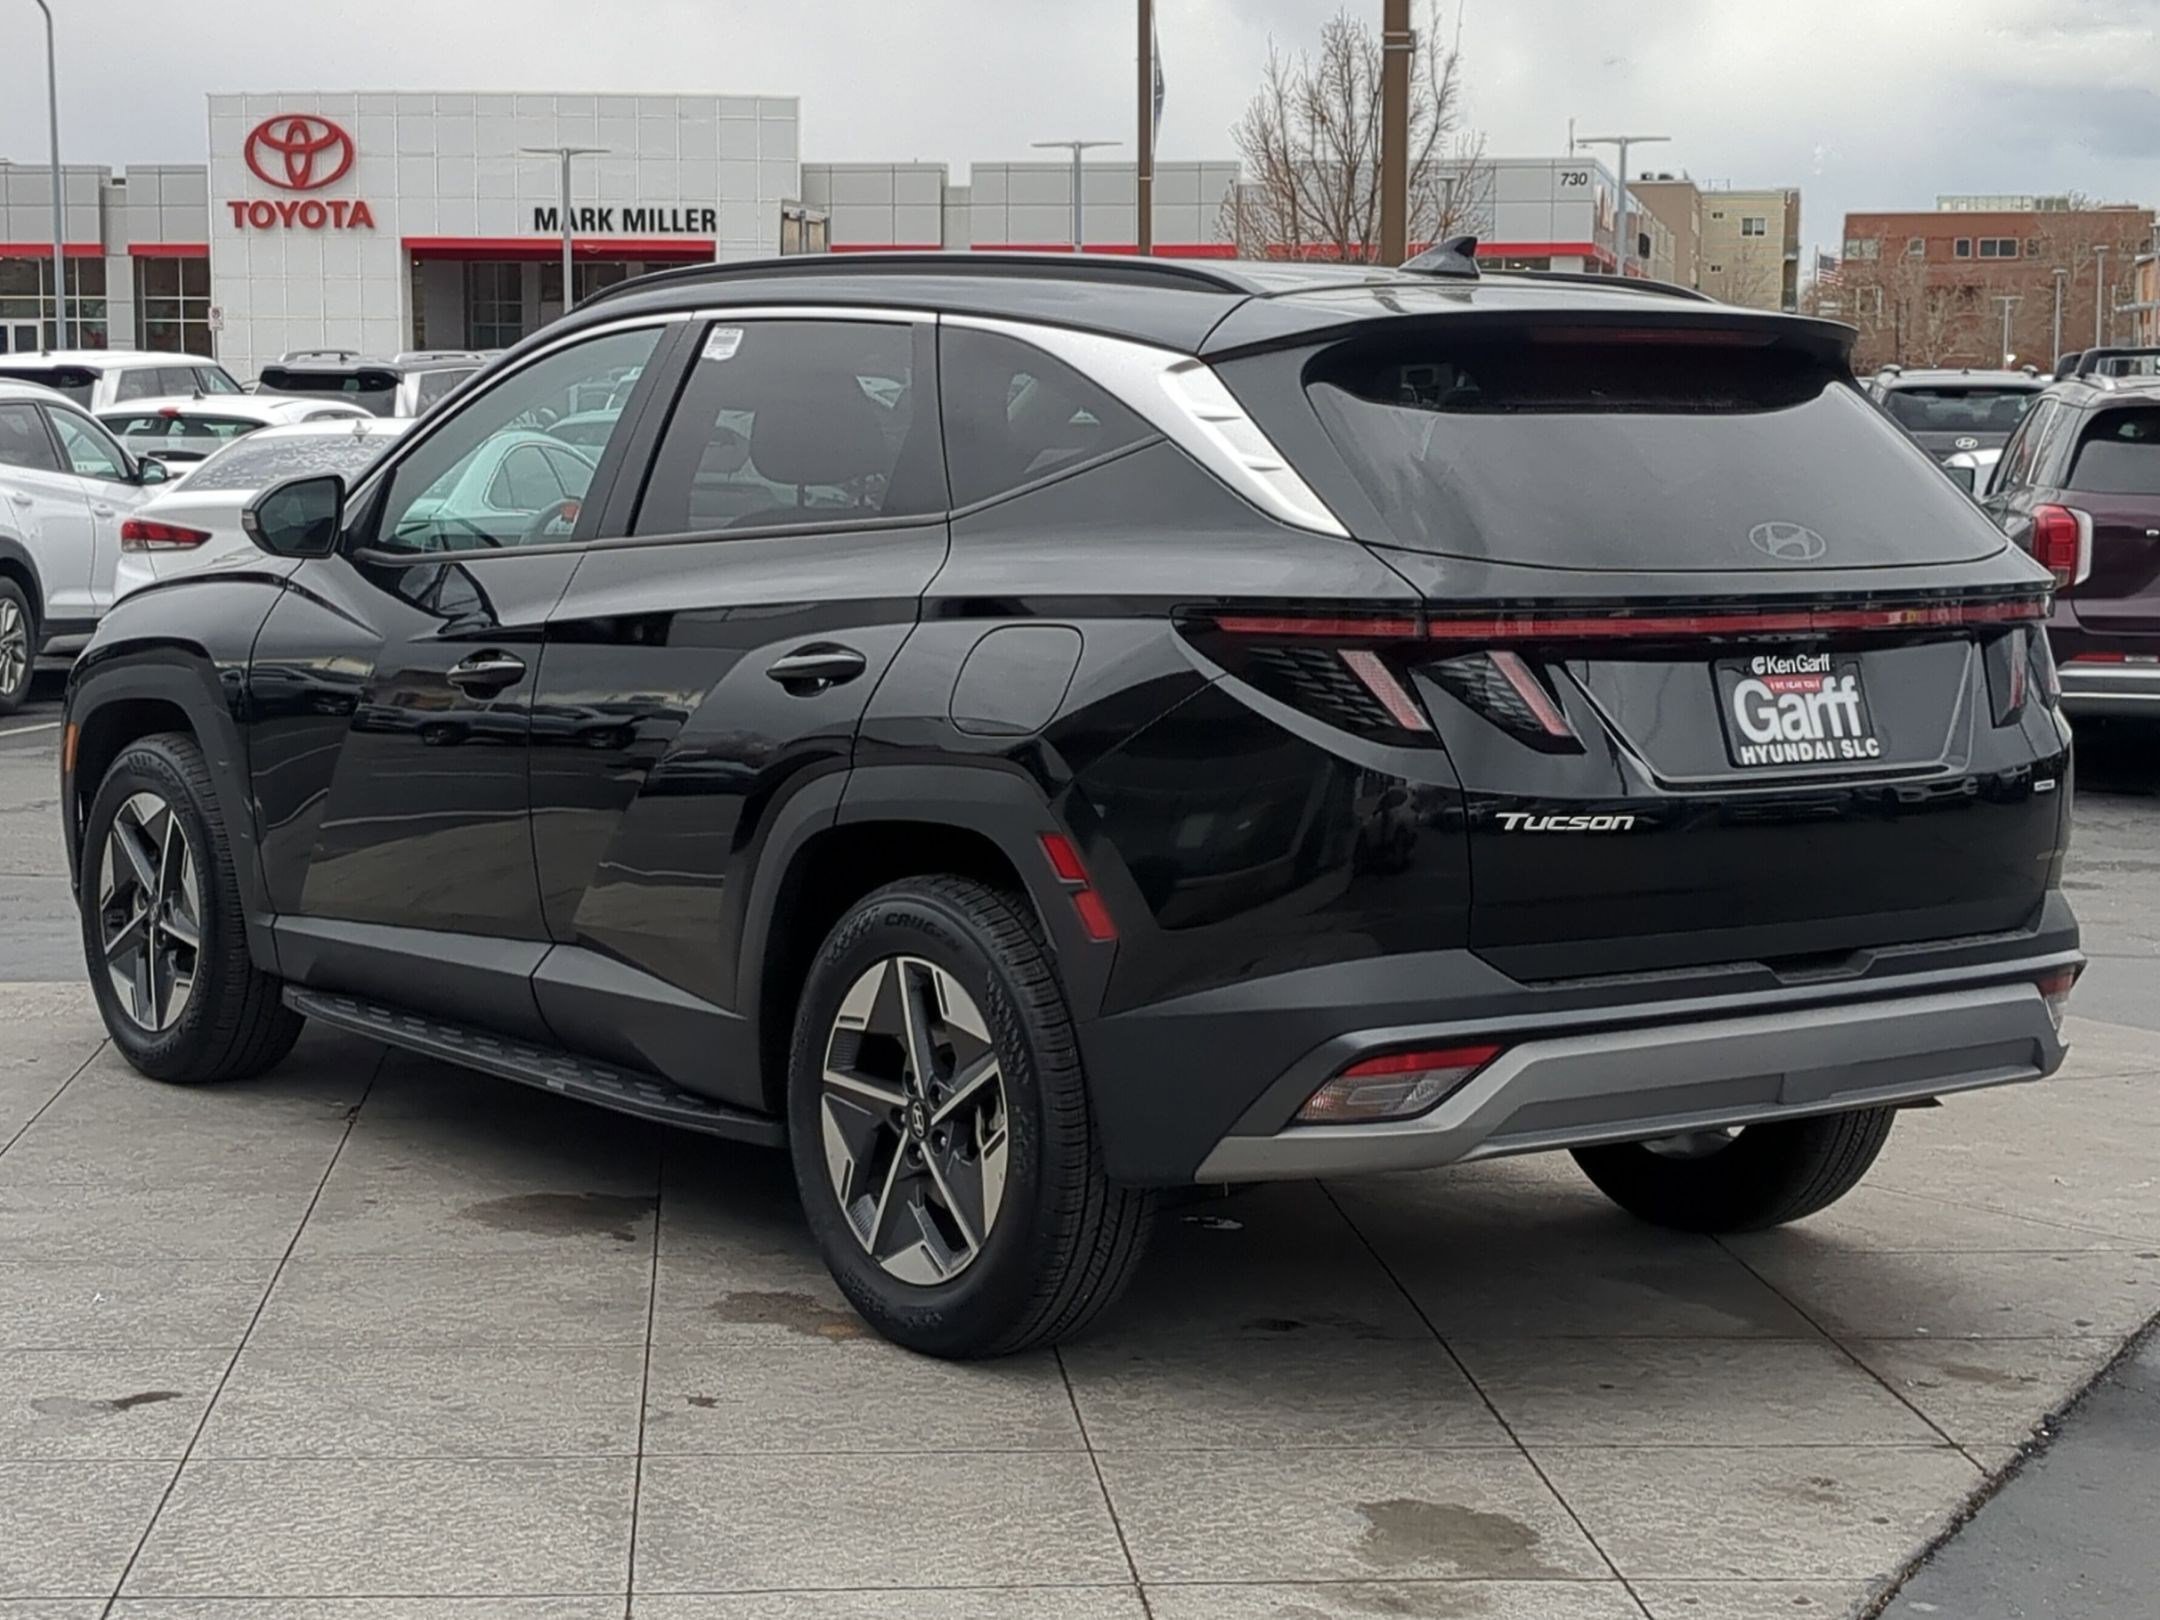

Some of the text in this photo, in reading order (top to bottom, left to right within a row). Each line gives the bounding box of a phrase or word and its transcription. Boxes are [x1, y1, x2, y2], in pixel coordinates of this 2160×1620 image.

[1560, 172, 1588, 187] 730
[227, 200, 374, 230] TOYOTA
[534, 207, 717, 232] MARK MILLER
[1766, 653, 1831, 674] Ken Garff
[1733, 675, 1862, 743] Garff
[1740, 737, 1880, 766] HYUNDAI SLC
[1495, 812, 1635, 831] Tucson
